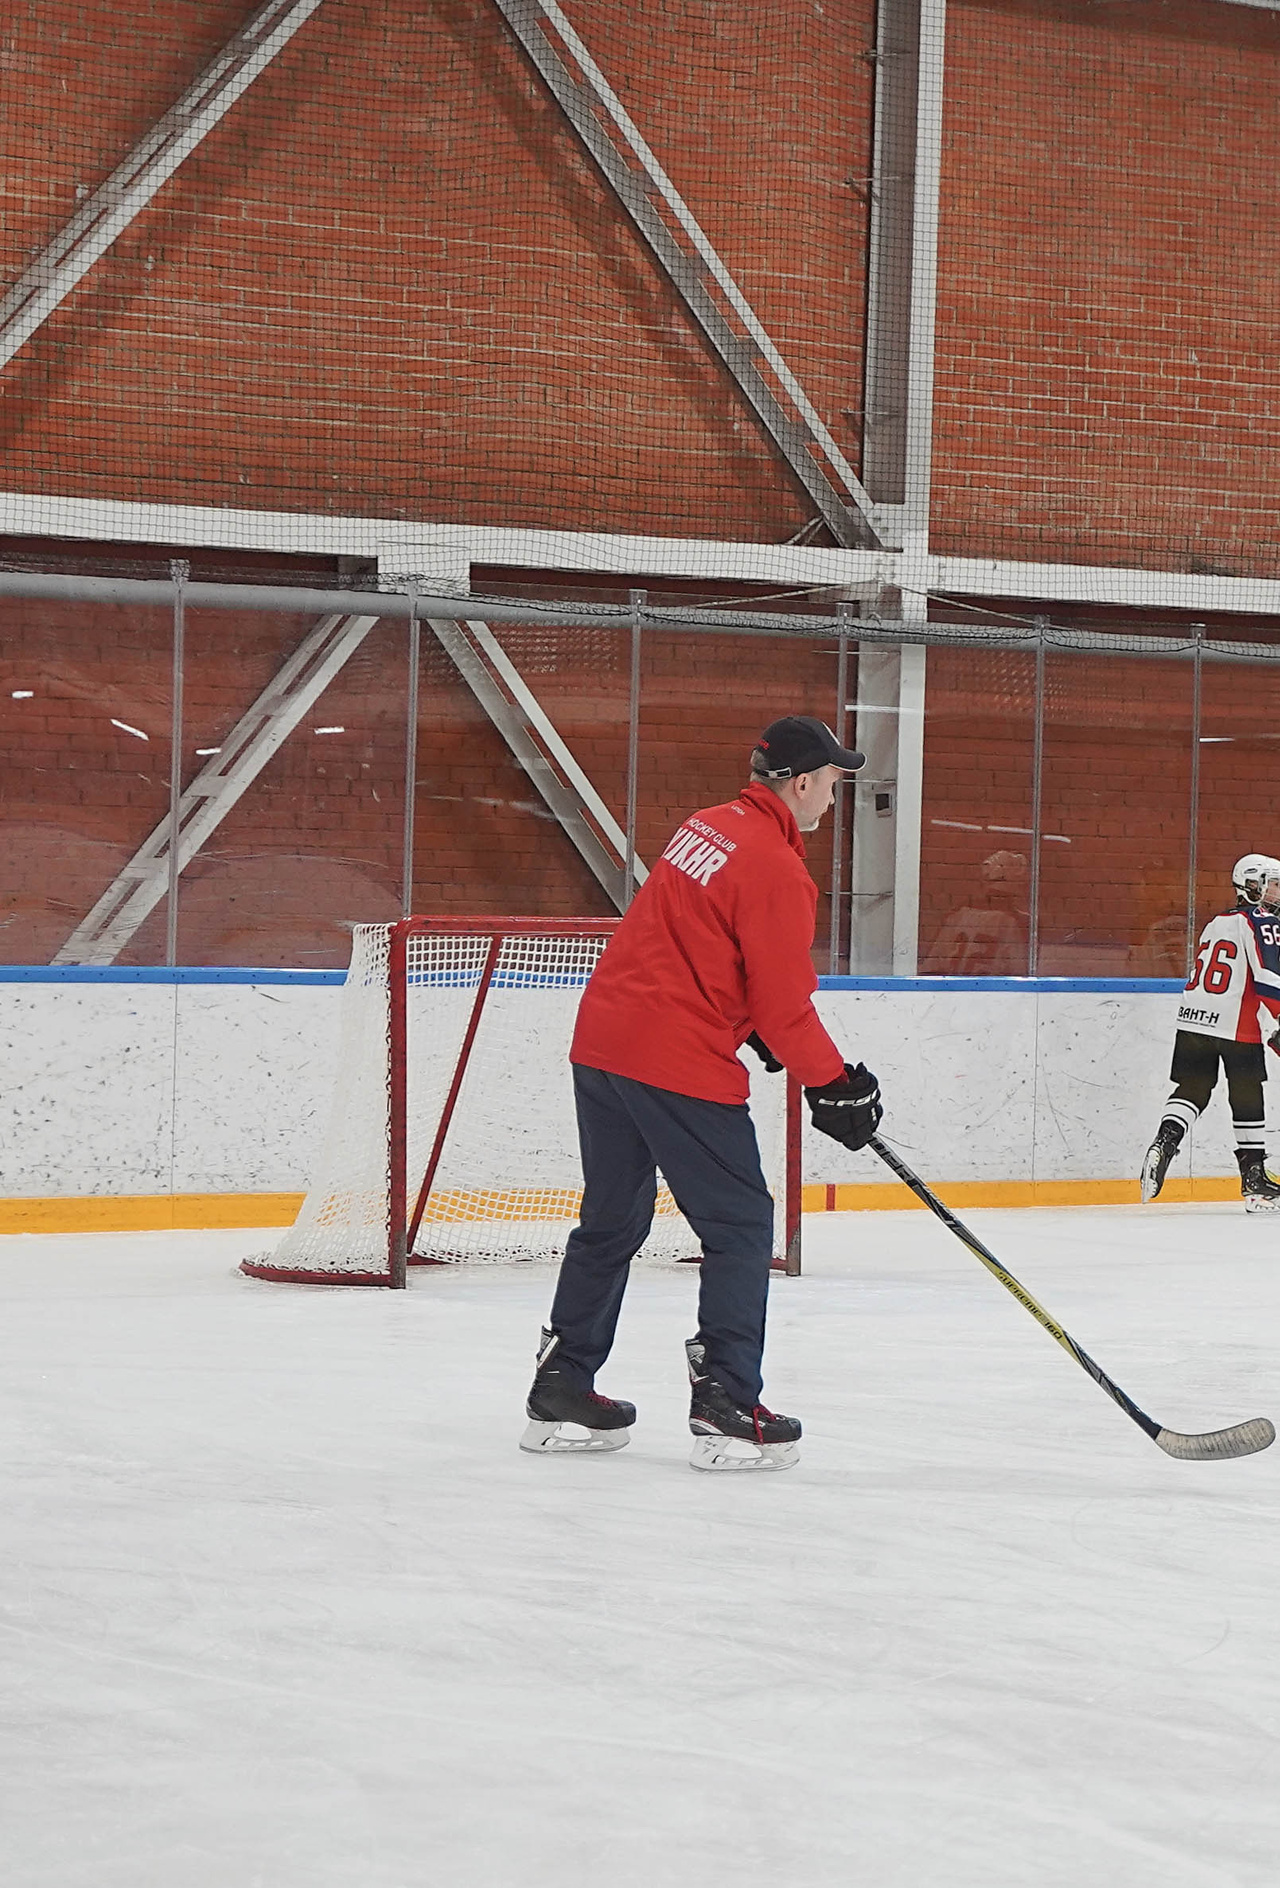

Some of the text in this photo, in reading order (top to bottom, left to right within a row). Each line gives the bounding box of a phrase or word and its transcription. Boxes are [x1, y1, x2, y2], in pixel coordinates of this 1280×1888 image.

[660, 826, 728, 887] VIKHR
[686, 818, 737, 852] HOCKEY CLUB
[1185, 939, 1237, 994] 56
